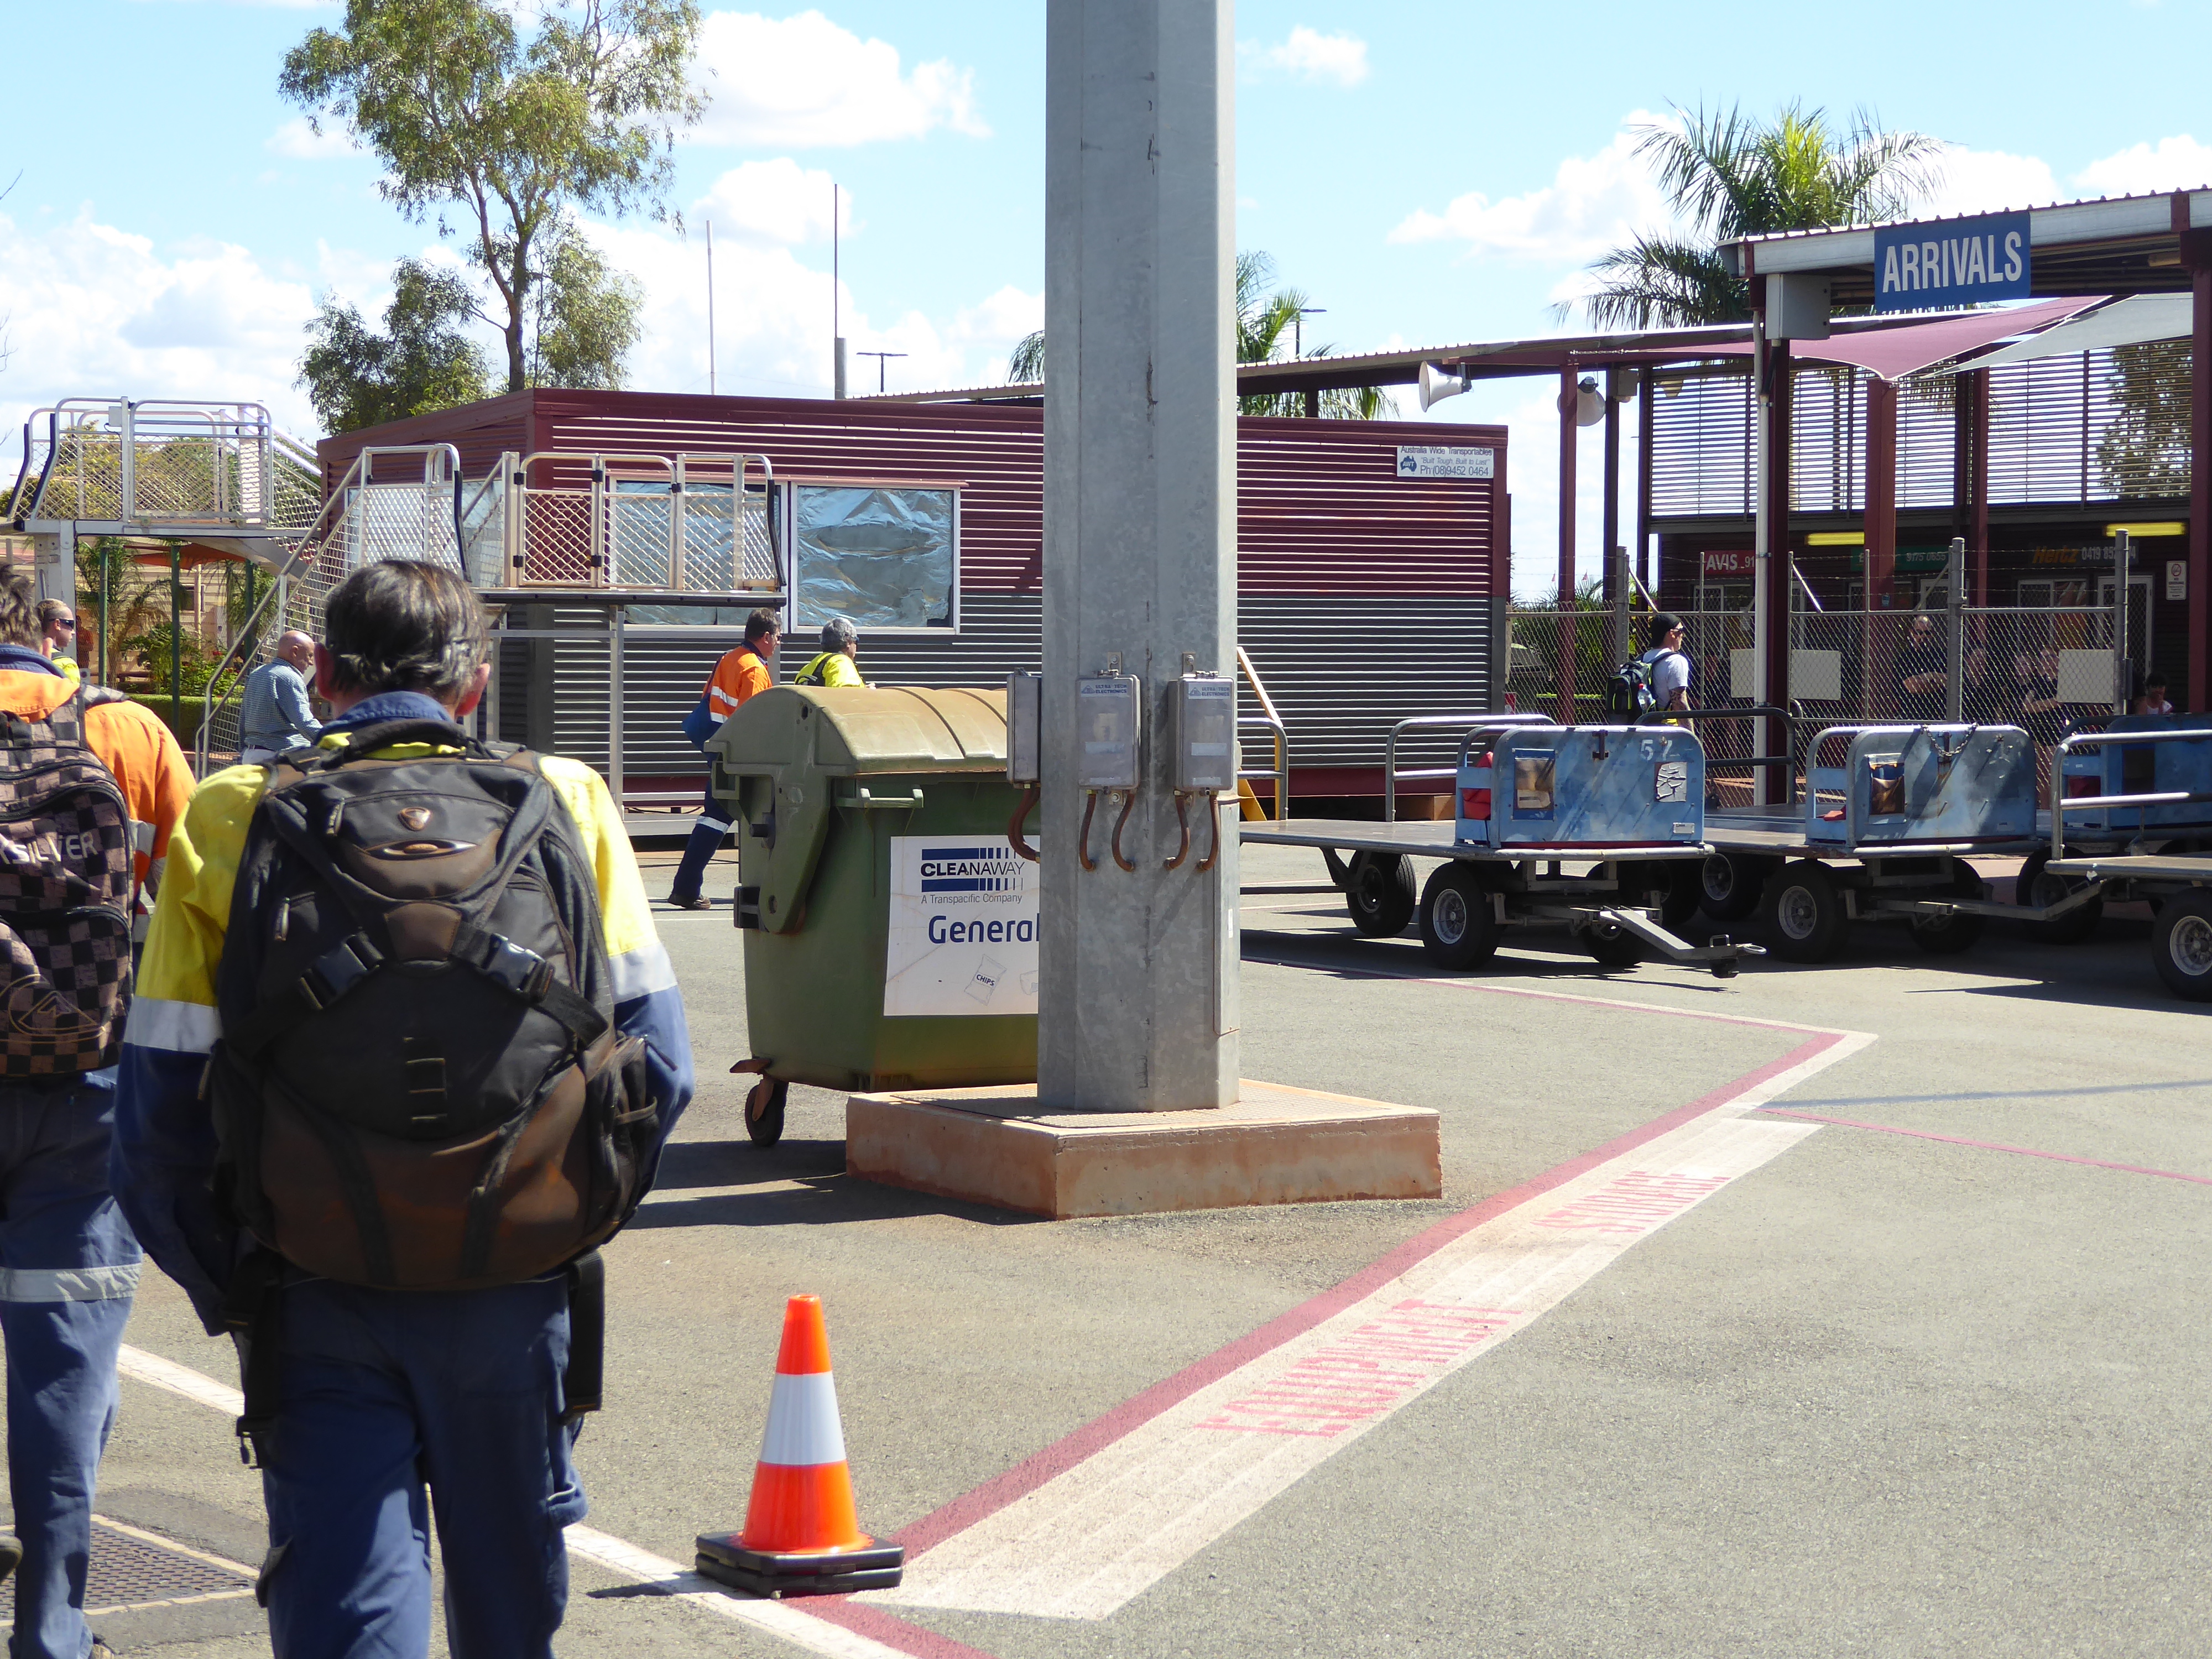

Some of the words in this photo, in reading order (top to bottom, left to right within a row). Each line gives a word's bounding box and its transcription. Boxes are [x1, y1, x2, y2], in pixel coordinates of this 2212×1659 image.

[1882, 231, 2022, 293] ARRIVALS
[1448, 447, 1492, 456] Transportables
[1469, 466, 1489, 476] 0464
[1705, 554, 1738, 571] AVIS
[2032, 545, 2079, 564] Hertz
[921, 862, 1025, 877] CLEANAWAY
[921, 895, 927, 904] A
[930, 894, 980, 905] Transpacific
[983, 893, 1022, 905] Company
[928, 913, 1040, 944] General
[976, 974, 995, 986] CHIPS
[1531, 1170, 1732, 1234] STORAGE
[1193, 1298, 1524, 1438] EQUIPMENT
